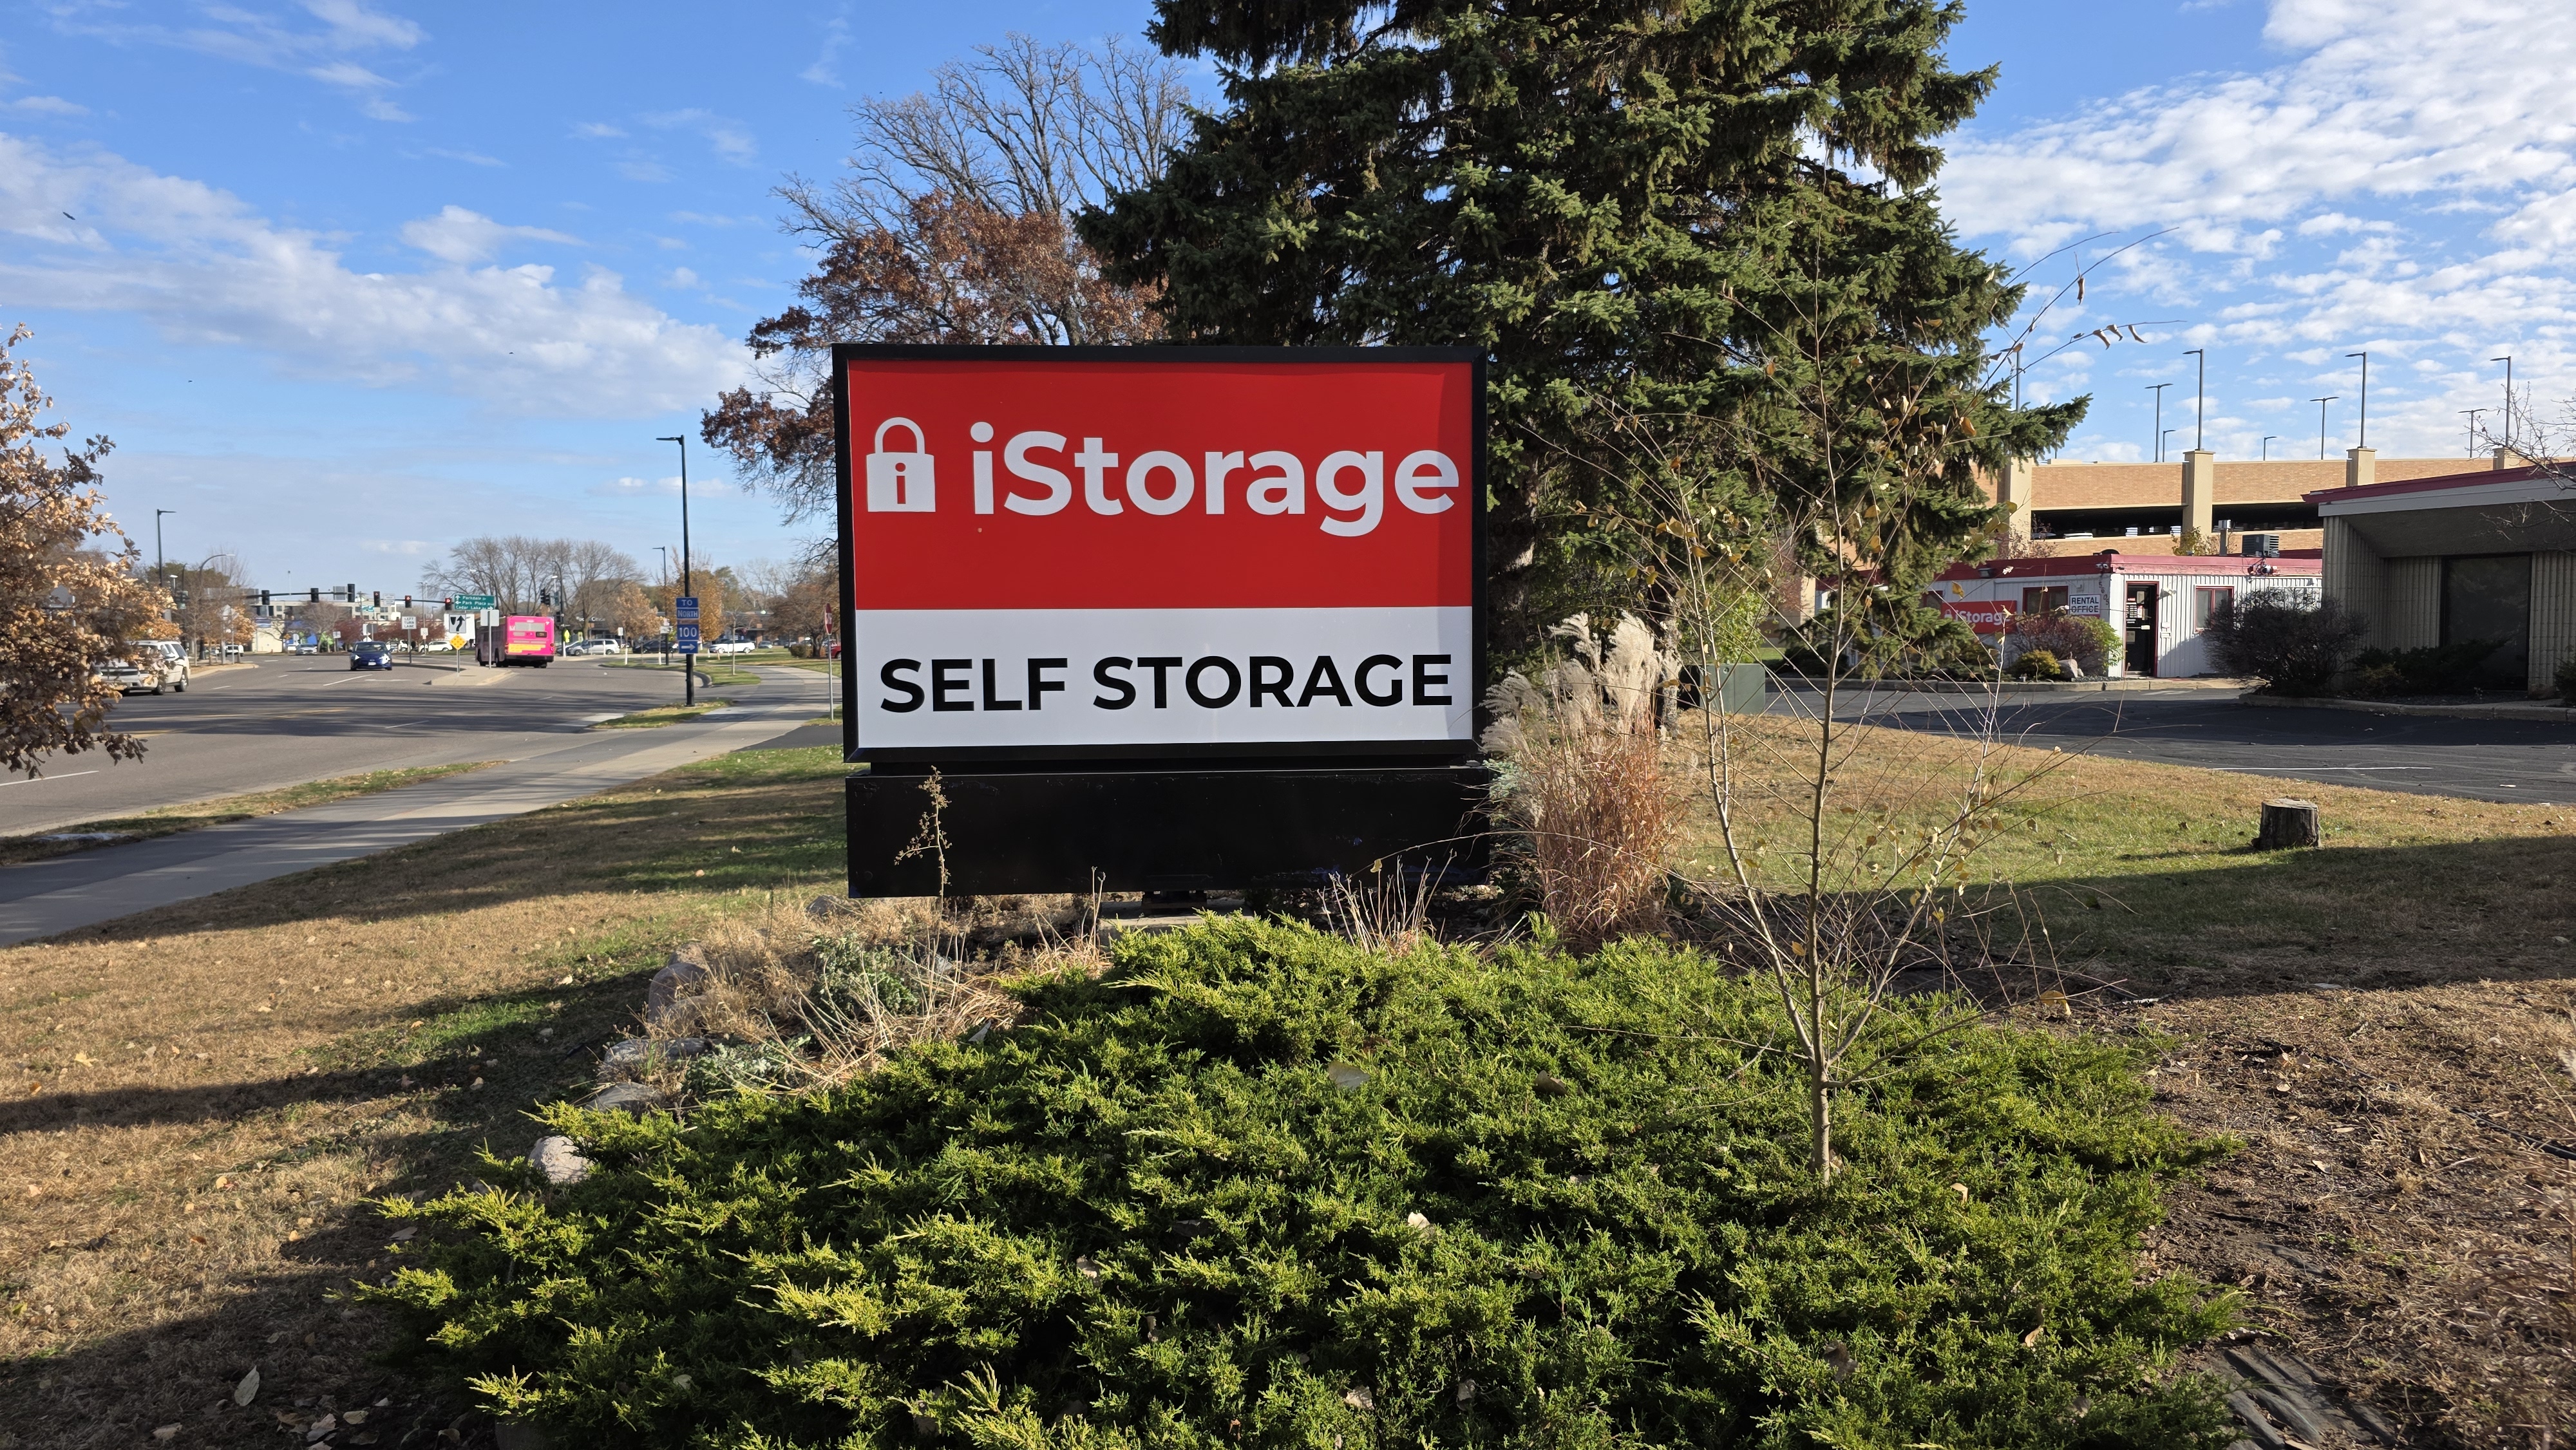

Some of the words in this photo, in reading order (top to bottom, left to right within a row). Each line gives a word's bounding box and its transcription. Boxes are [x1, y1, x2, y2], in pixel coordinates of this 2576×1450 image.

[970, 421, 1459, 537] iStorage
[2098, 581, 2110, 605] 5605
[679, 627, 697, 637] 100
[880, 655, 1068, 713] SELF
[1092, 654, 1453, 710] STORAGE
